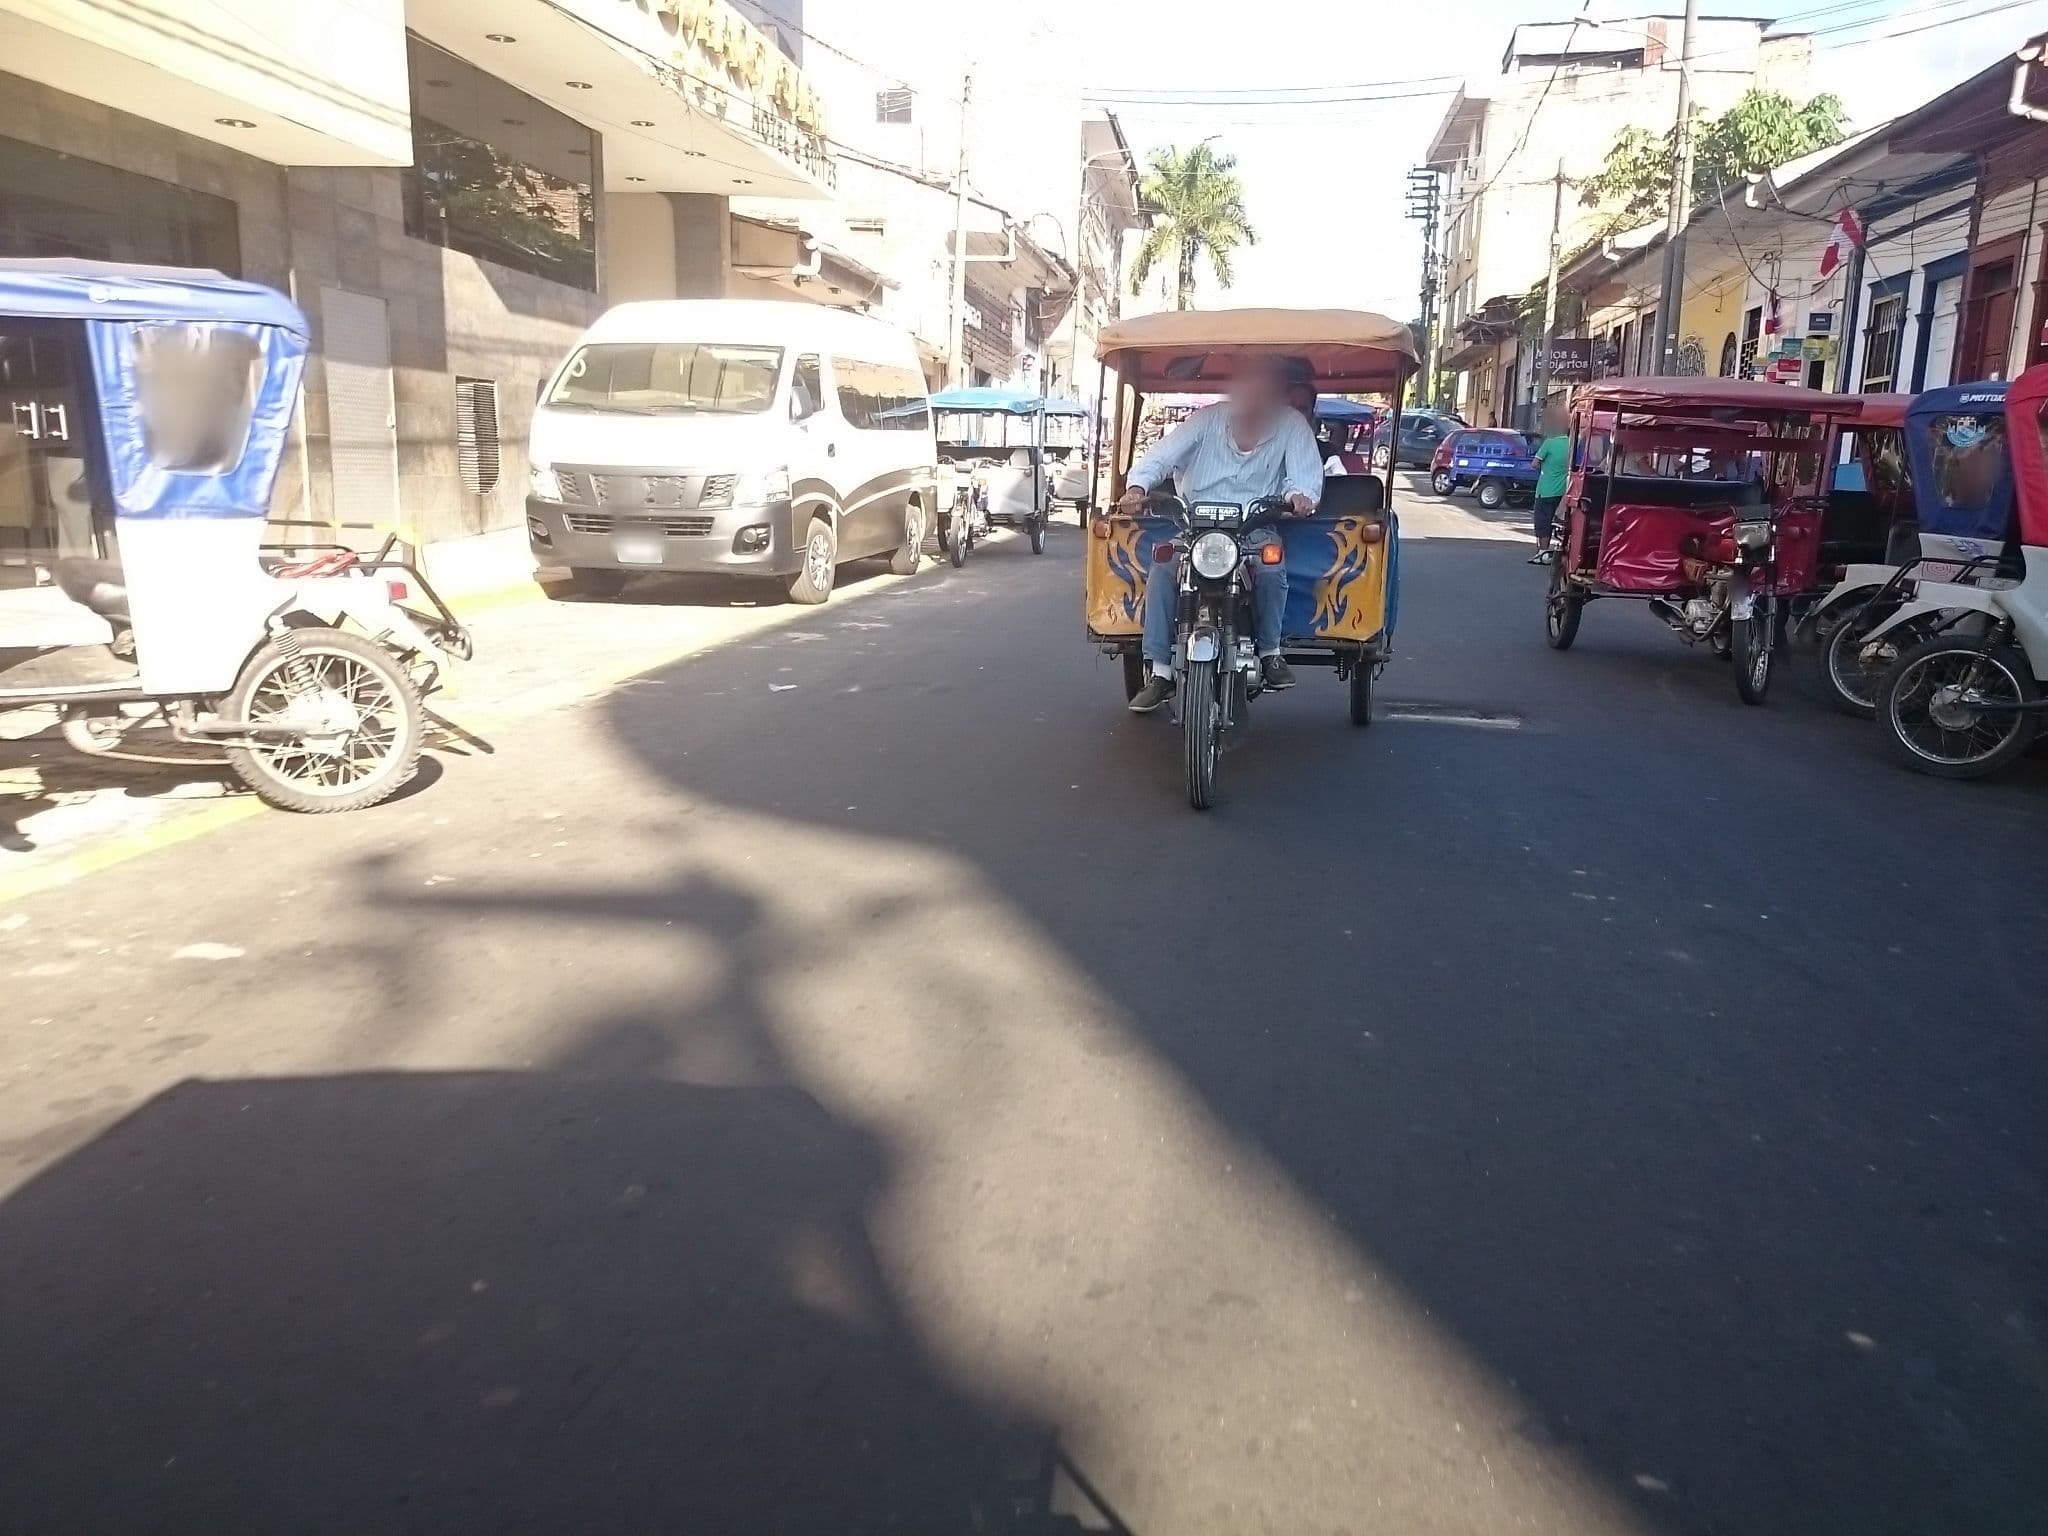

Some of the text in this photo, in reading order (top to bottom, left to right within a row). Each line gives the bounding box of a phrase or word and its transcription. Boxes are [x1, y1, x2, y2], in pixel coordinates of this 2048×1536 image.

[752, 102, 789, 157] HOTEL
[804, 143, 837, 191] SUITES
[1571, 350, 1579, 359] &
[1535, 359, 1588, 369] cbiertos
